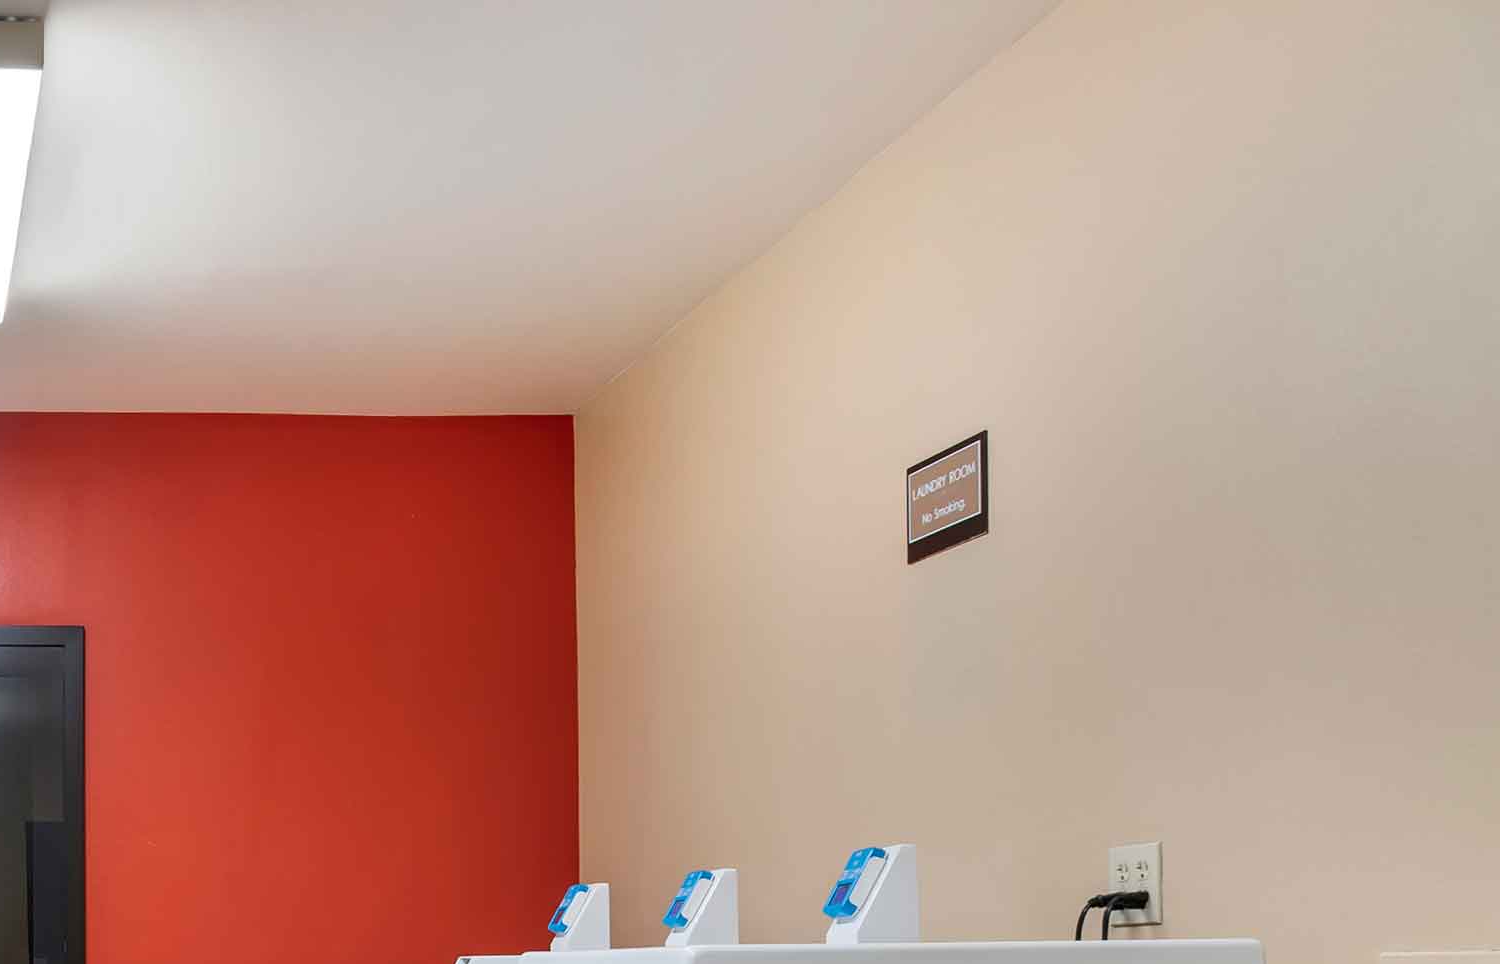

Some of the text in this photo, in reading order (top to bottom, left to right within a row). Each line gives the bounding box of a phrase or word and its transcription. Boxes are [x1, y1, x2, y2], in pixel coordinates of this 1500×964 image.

[912, 461, 976, 501] LAUNDRY ROOM
[921, 498, 965, 525] No Smoking
